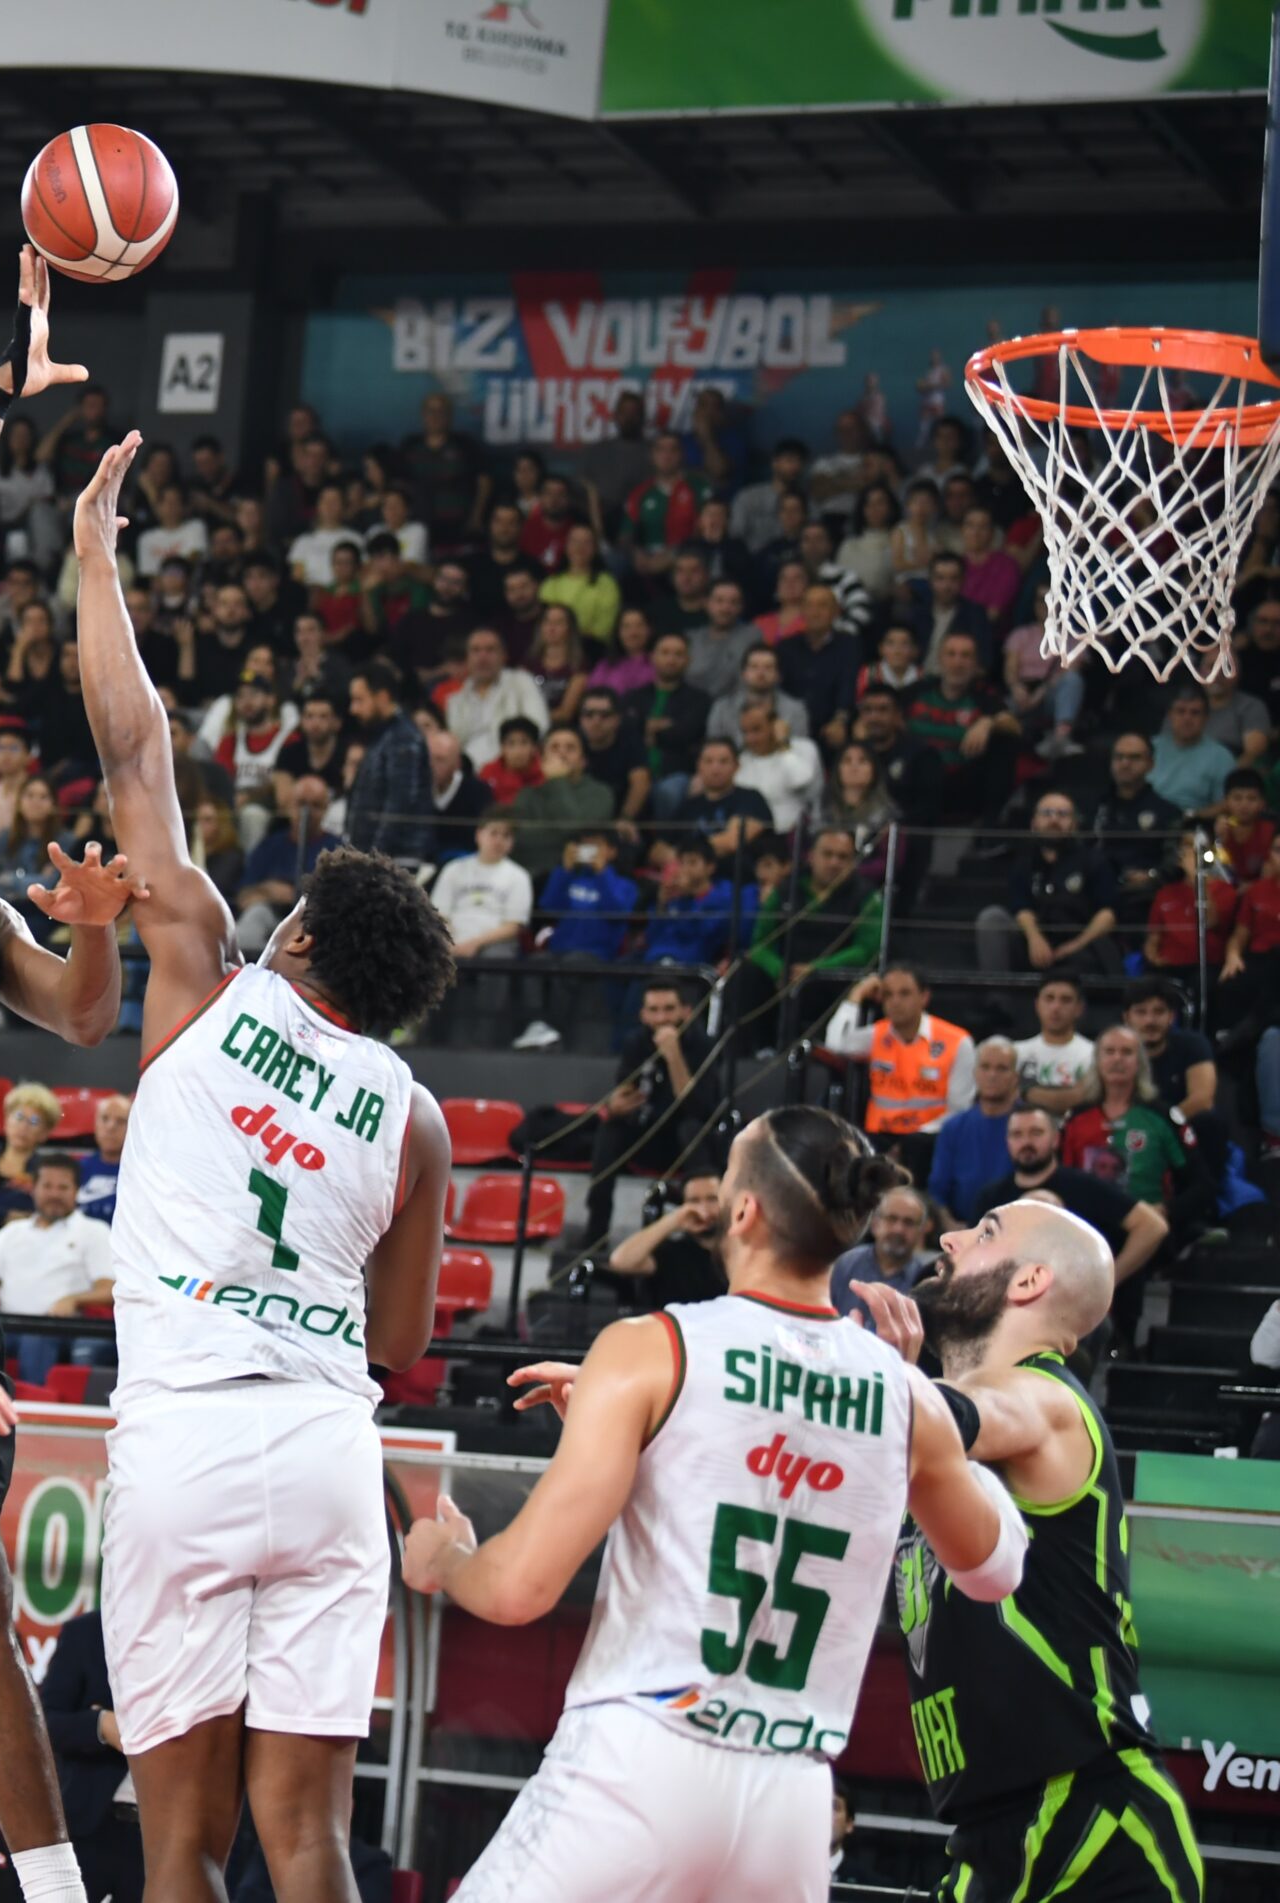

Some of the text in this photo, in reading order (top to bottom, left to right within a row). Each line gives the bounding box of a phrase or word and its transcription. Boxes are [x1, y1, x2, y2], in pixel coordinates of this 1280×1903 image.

[167, 352, 215, 392] A2
[542, 294, 847, 370] VOLEYBOL
[220, 1012, 386, 1143] CAREY JR
[230, 1103, 326, 1171] dyo
[247, 1167, 301, 1272] 1
[723, 1345, 885, 1437] SİPAHİ
[745, 1432, 845, 1500] dyo
[699, 1501, 852, 1693] 55
